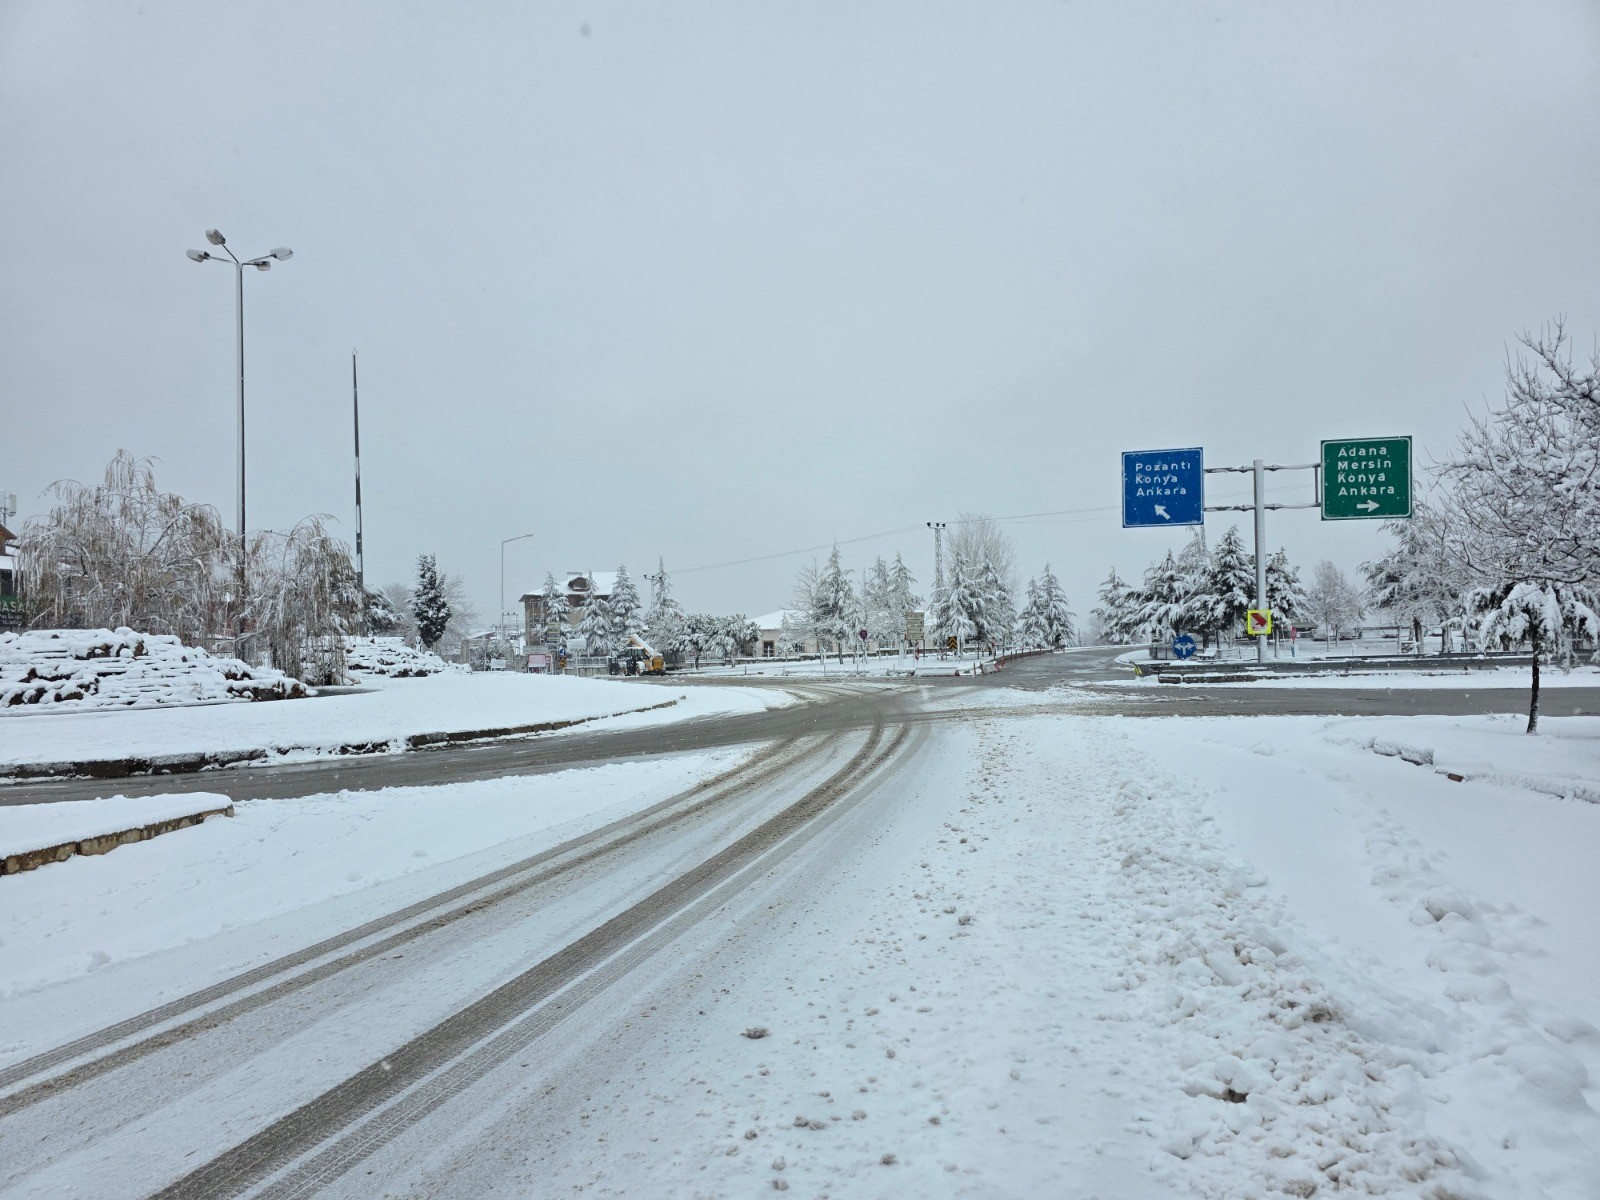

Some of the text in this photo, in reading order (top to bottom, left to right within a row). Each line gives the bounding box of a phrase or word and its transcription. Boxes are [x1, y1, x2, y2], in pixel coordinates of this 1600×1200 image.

[1338, 446, 1387, 457] Adana
[1338, 458, 1392, 470] Mersin
[1136, 474, 1178, 485] Konya
[1338, 472, 1386, 484] Konya
[1136, 486, 1186, 496] Ankara
[1338, 486, 1394, 496] Ankara
